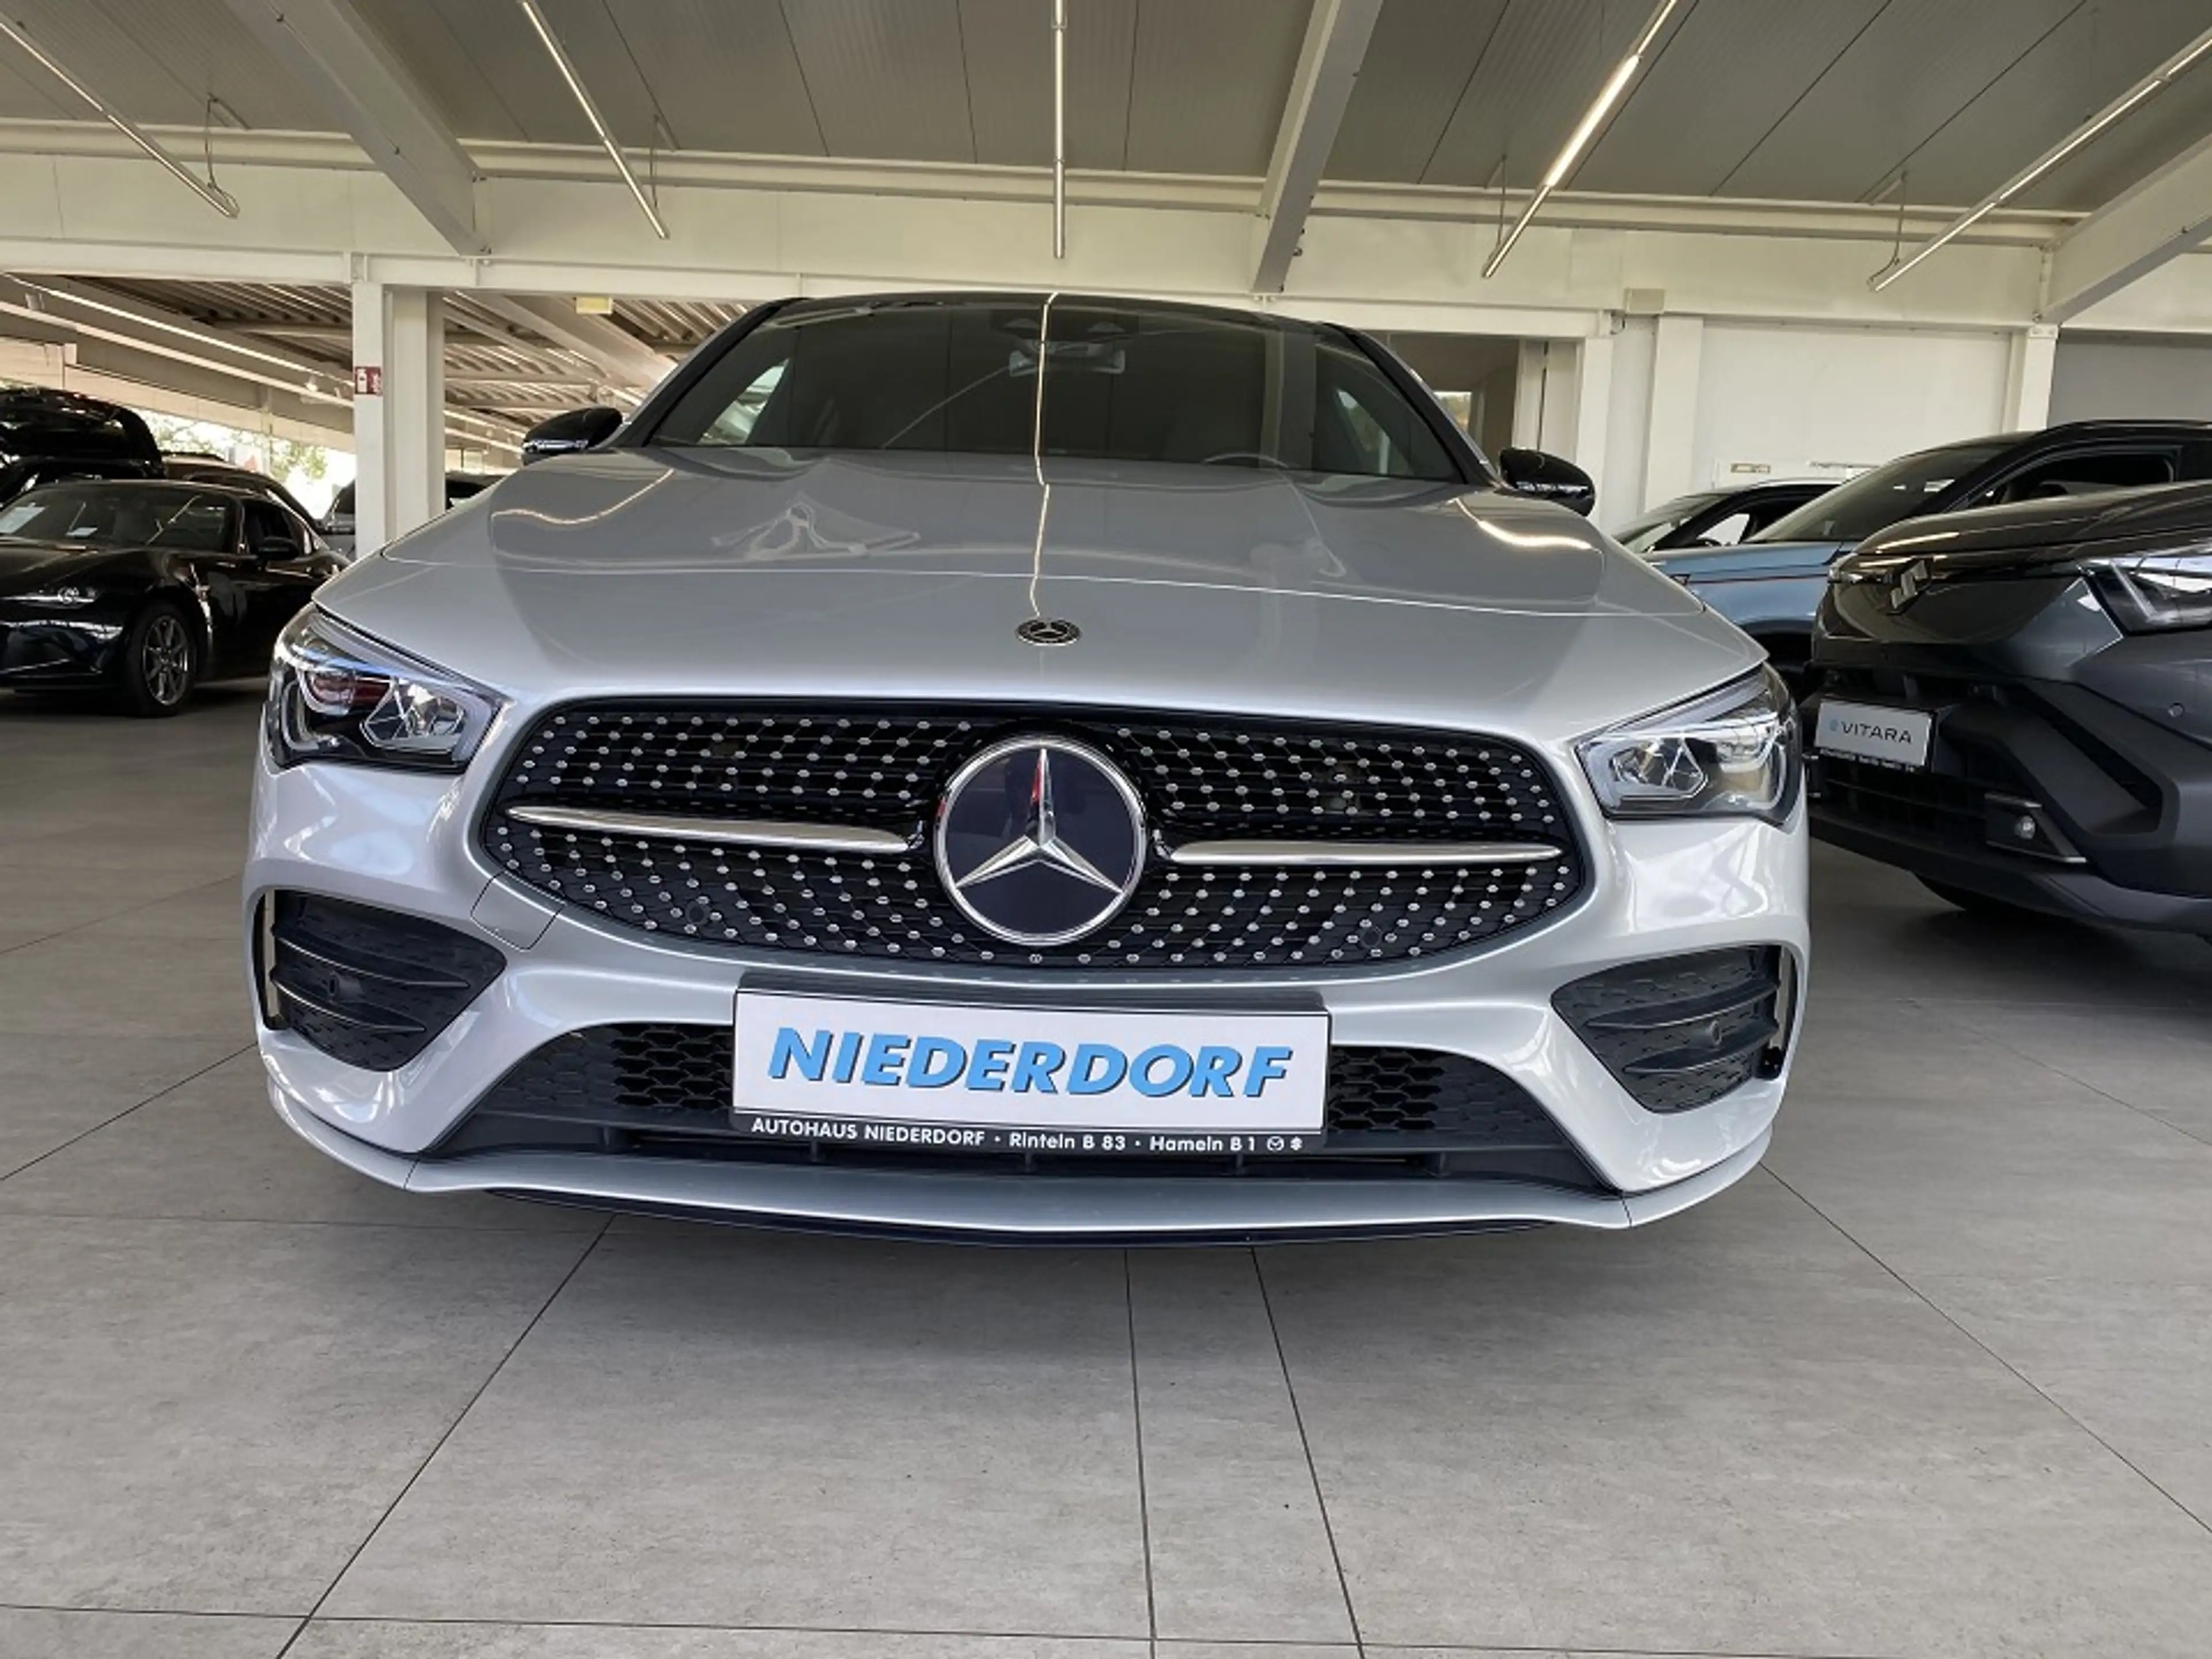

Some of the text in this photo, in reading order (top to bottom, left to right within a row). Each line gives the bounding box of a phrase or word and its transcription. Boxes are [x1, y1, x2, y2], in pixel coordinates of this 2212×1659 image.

[767, 1027, 1293, 1098] NIEDERDORF
[751, 1117, 1256, 1152] AUTOHAUS NIEDERDORF Rinteln B 83 Hameln B 1
